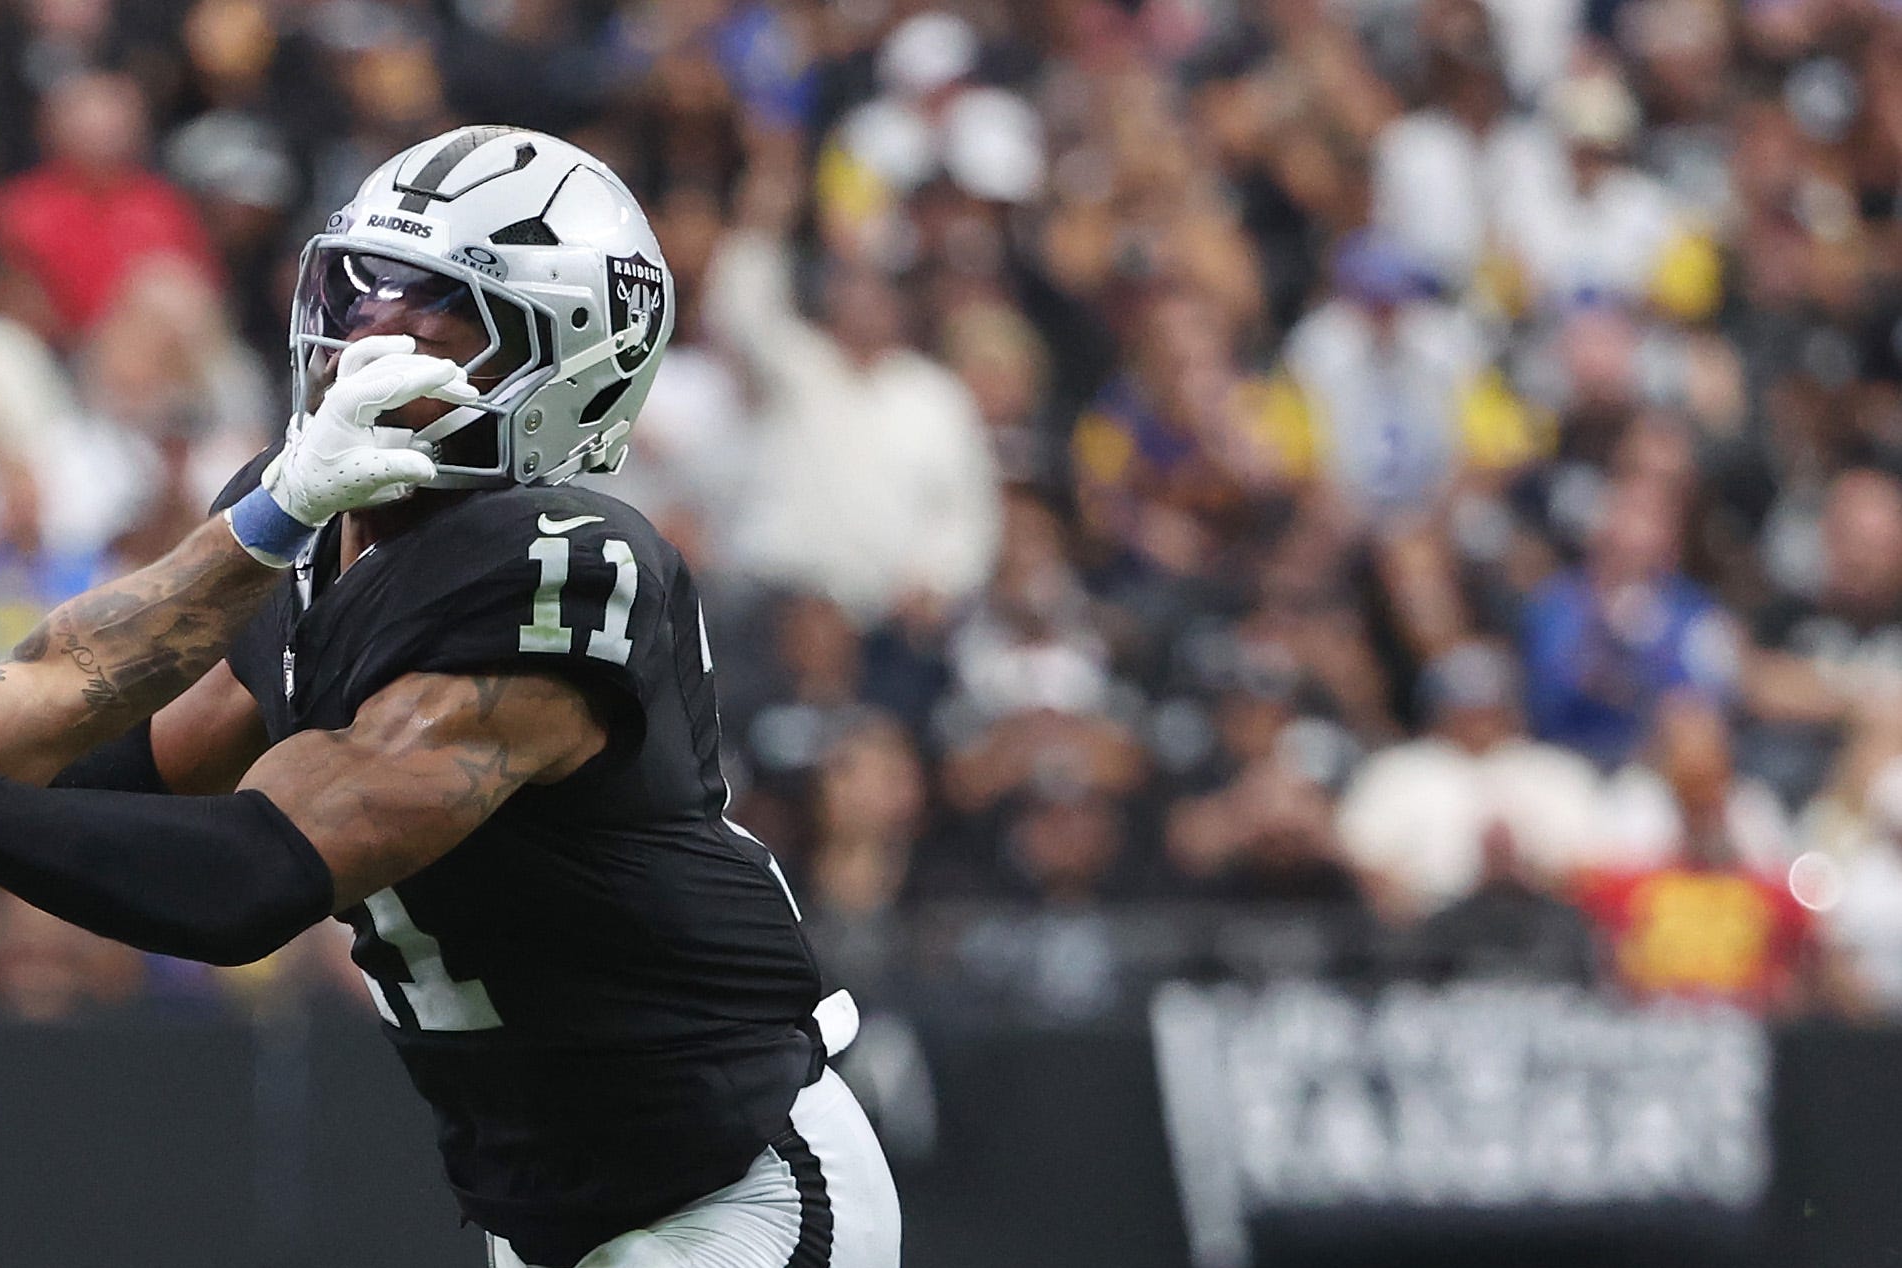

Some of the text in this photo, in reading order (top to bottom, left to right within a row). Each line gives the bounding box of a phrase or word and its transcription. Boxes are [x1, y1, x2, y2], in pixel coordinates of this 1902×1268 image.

[367, 214, 432, 239] RAIDERS
[613, 260, 661, 284] RAIDERS
[519, 537, 638, 666] 11
